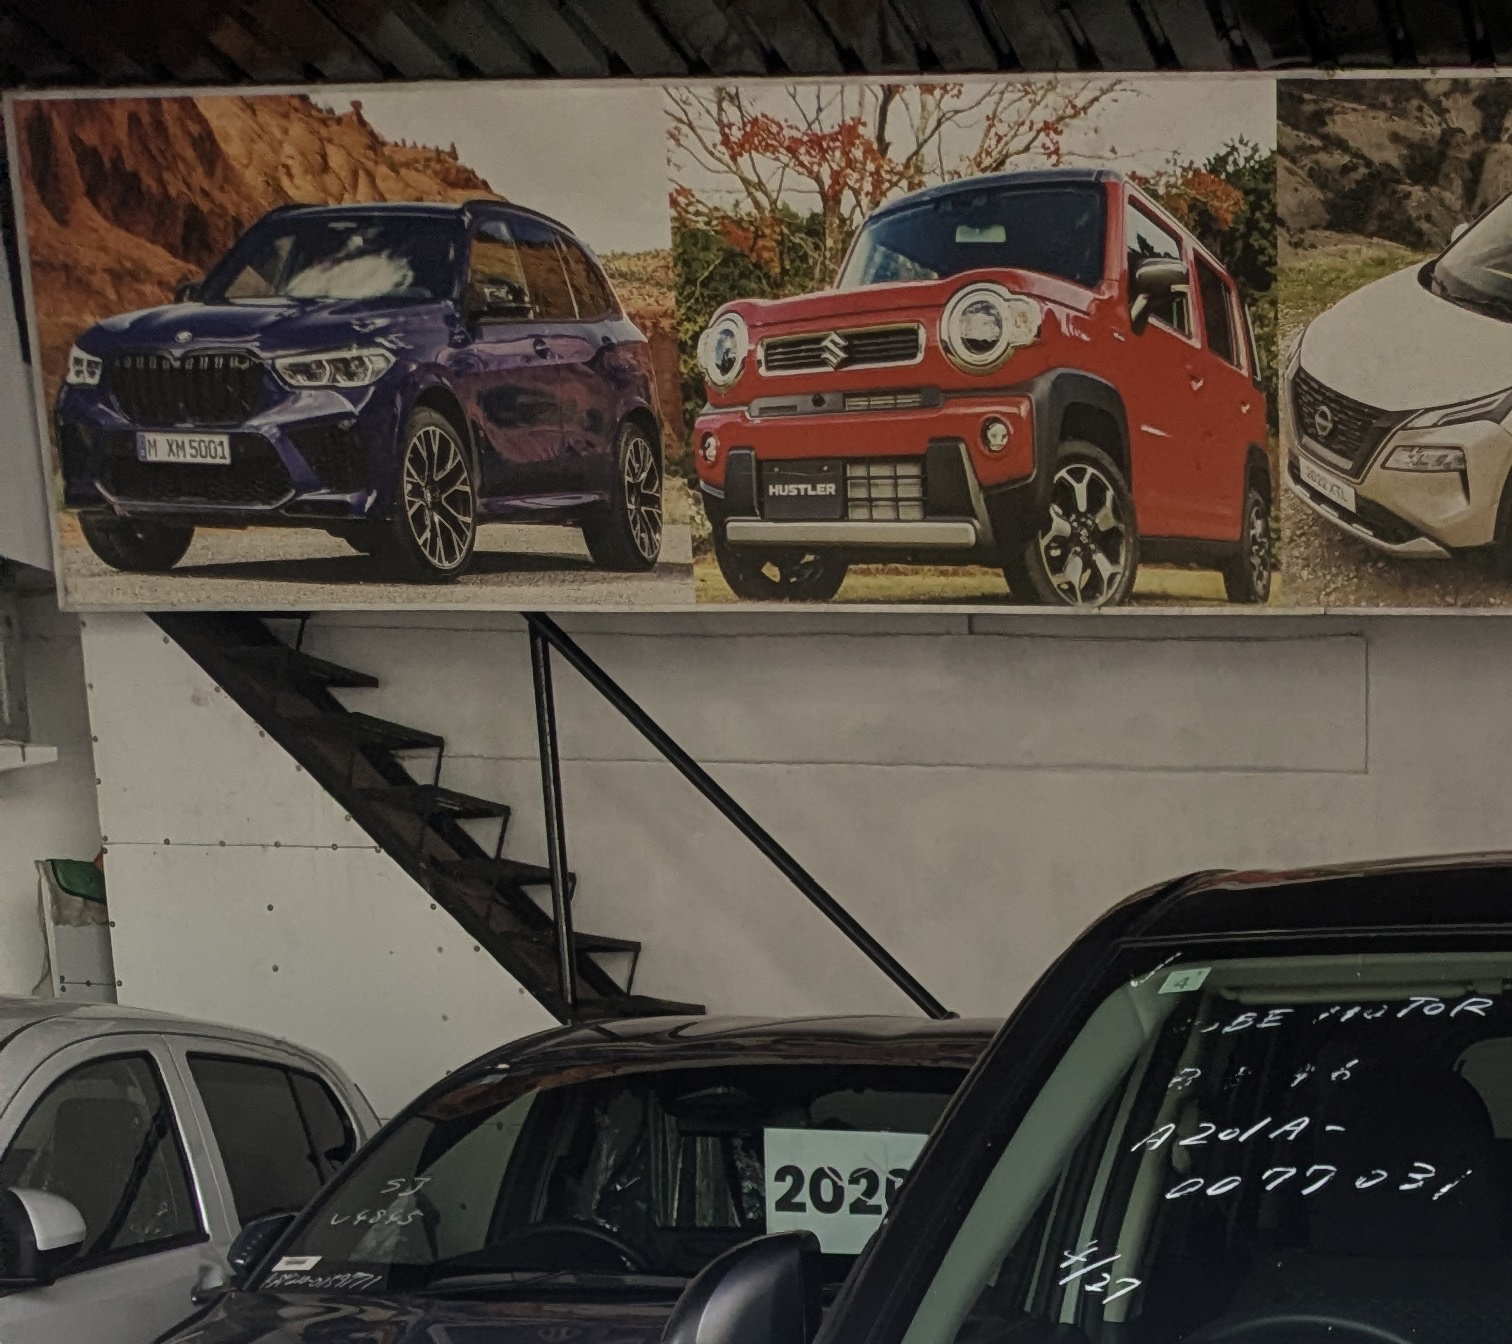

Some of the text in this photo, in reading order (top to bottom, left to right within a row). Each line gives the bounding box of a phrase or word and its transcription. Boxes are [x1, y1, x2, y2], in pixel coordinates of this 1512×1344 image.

[165, 438, 187, 459] XM
[188, 439, 228, 460] 5001
[768, 483, 836, 496] HUSTLER
[1164, 1162, 1473, 1200] 0077031
